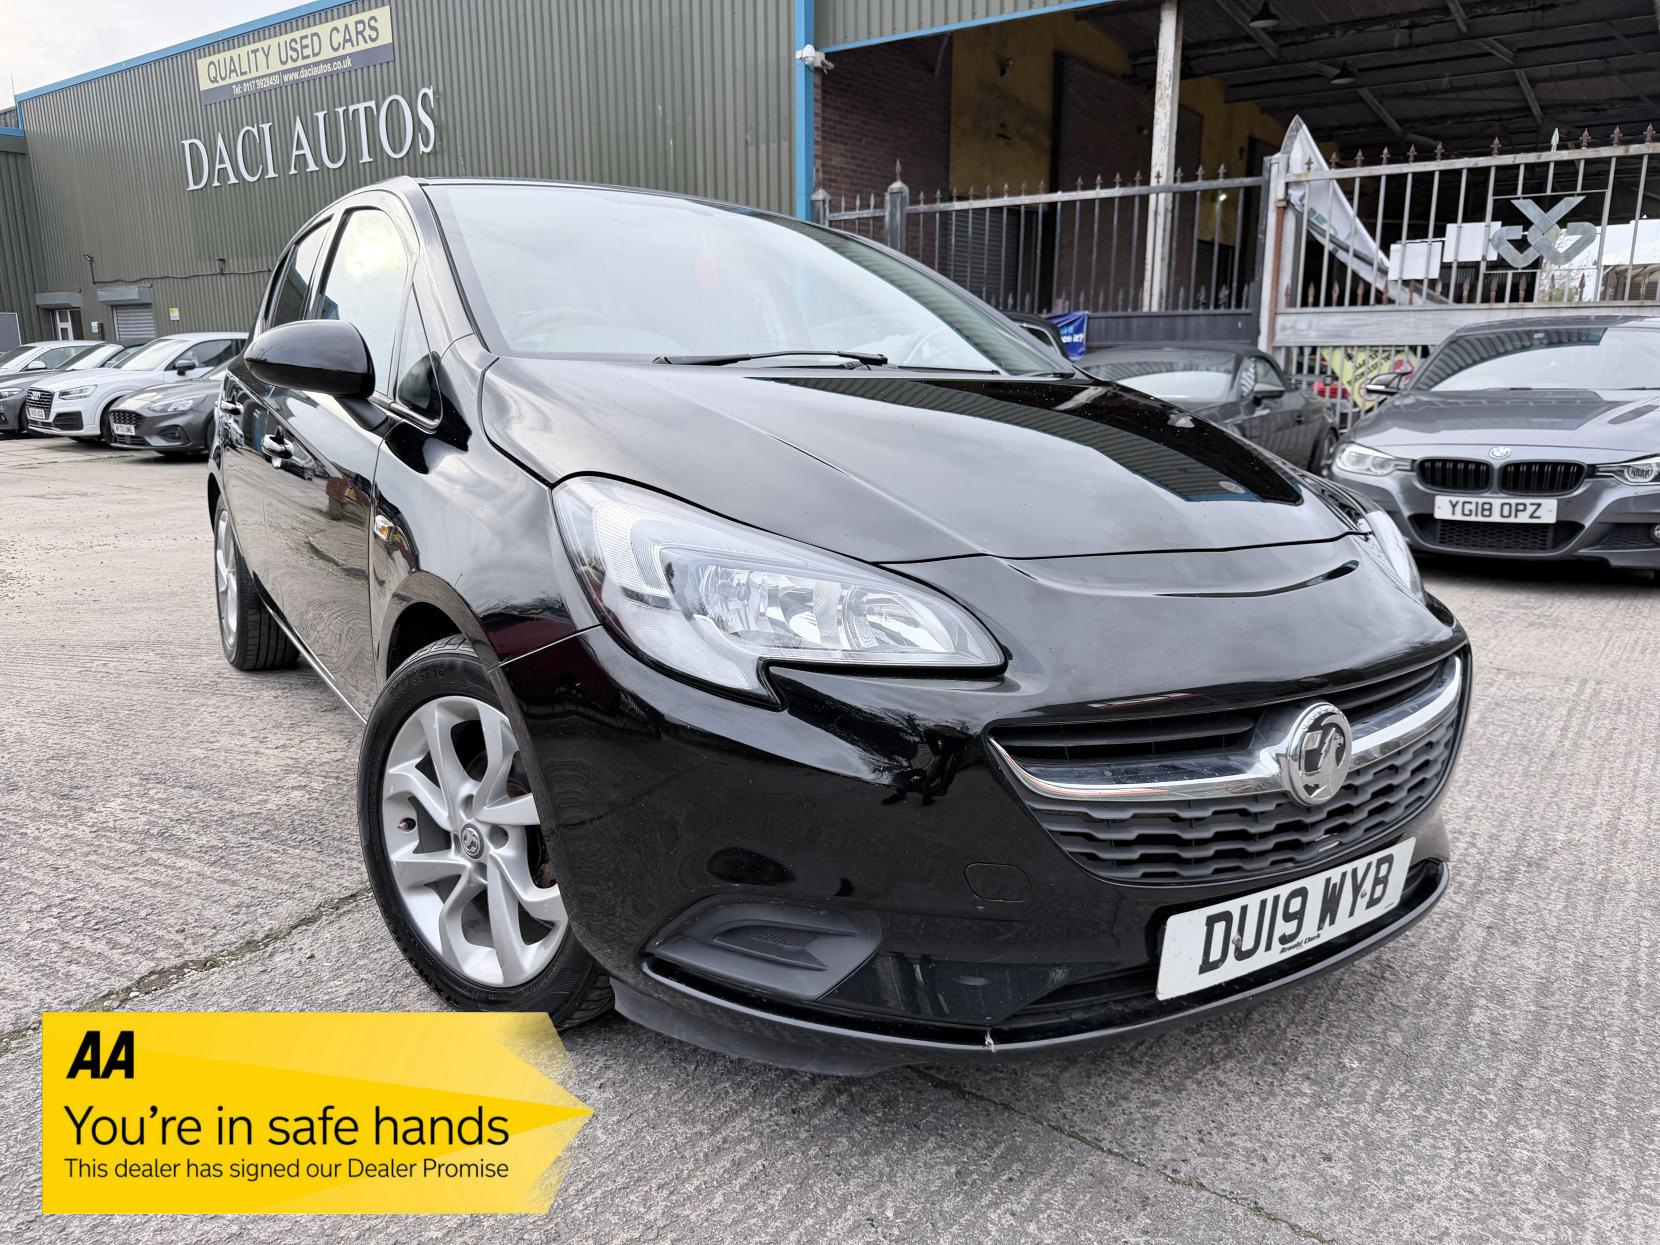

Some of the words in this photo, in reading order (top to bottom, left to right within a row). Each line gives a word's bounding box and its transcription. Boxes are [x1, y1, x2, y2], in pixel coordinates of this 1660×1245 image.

[207, 45, 272, 84] QUALITY
[277, 32, 322, 66] USED
[329, 15, 380, 52] CARS
[232, 84, 243, 95] Tel:
[283, 56, 353, 83] www.daciautos.co.uk
[181, 122, 279, 191] DACI
[288, 85, 436, 175] AUTOS
[1448, 500, 1493, 518] YG18
[1500, 502, 1543, 519] OPZ
[1198, 886, 1309, 975] DU19
[1317, 853, 1395, 931] WYB
[1304, 933, 1321, 945] Clark
